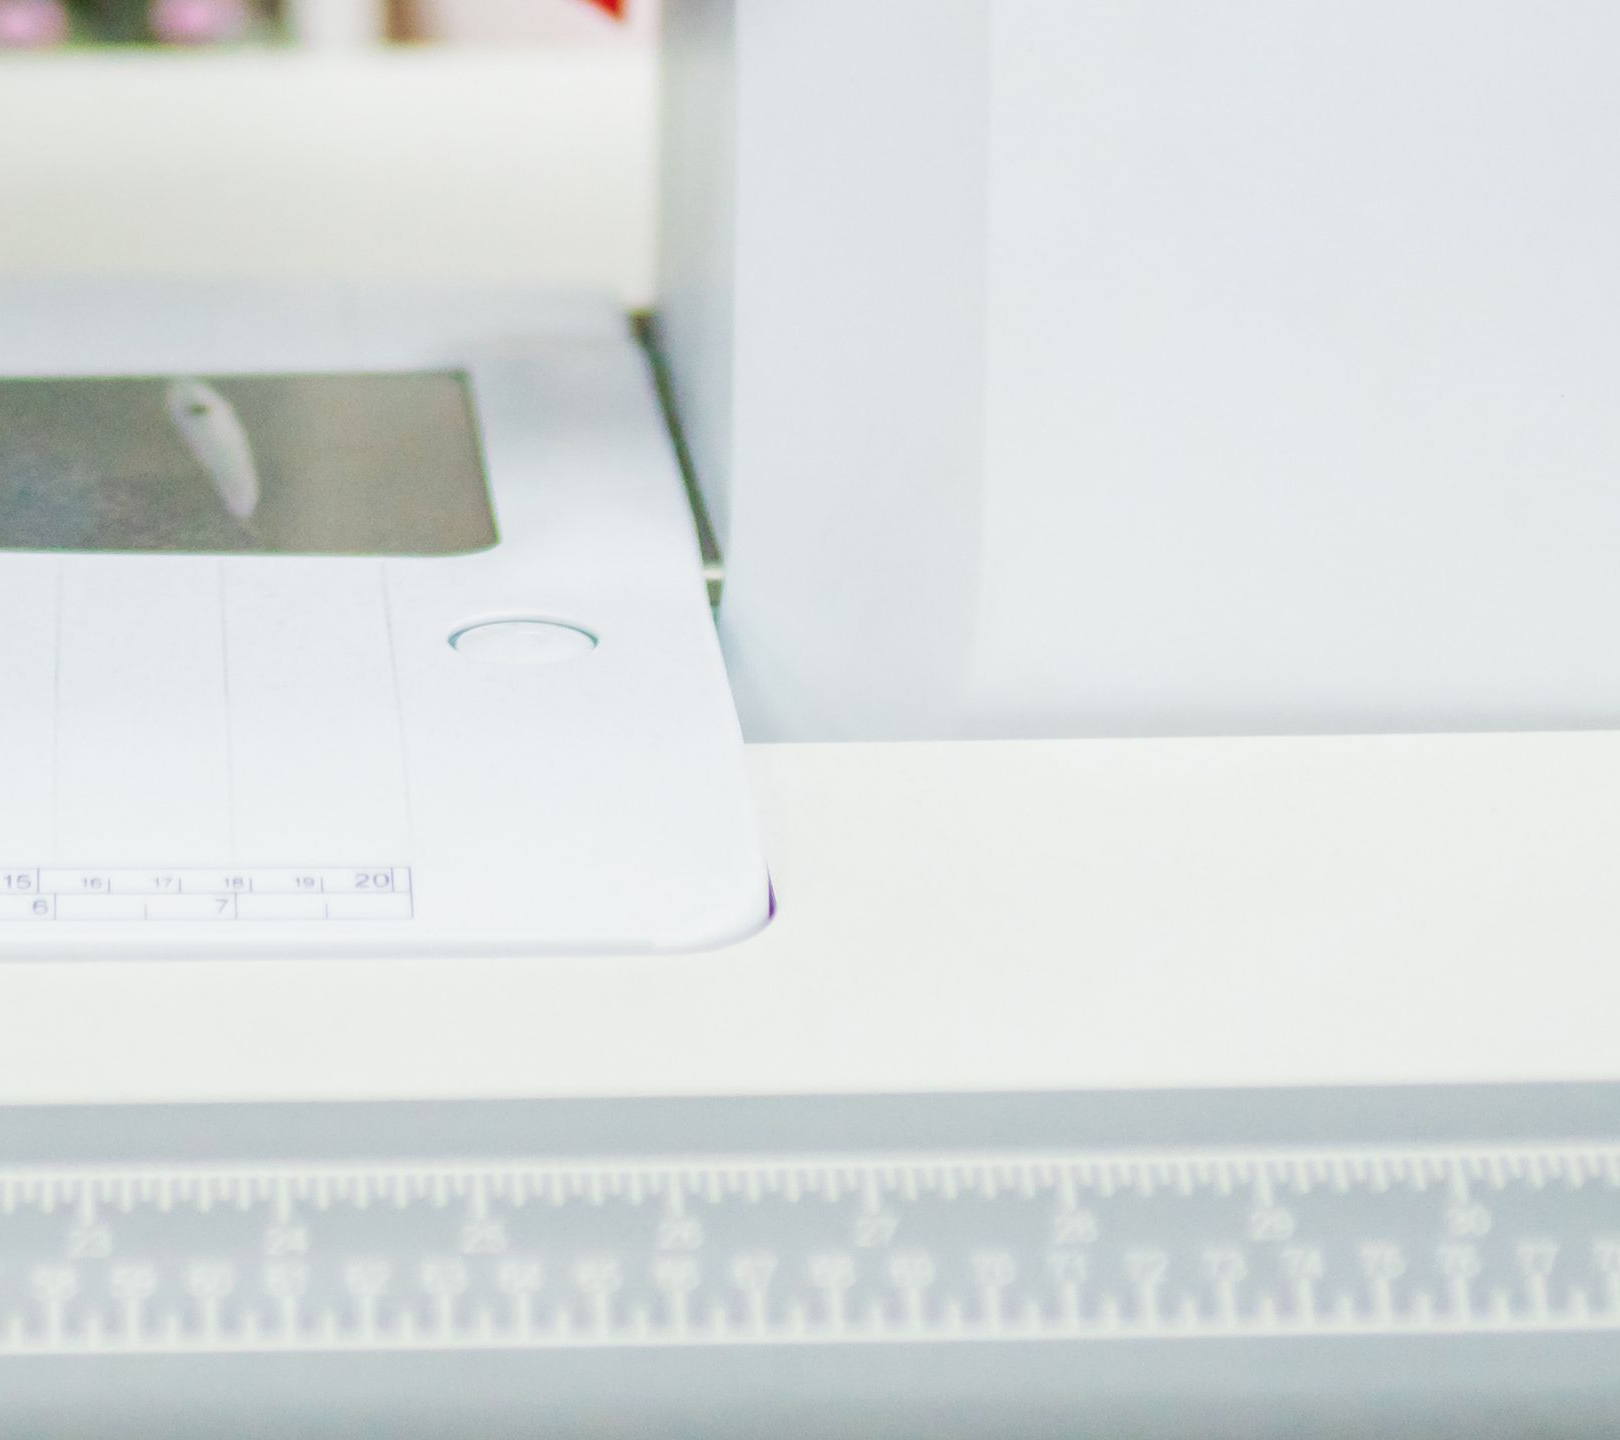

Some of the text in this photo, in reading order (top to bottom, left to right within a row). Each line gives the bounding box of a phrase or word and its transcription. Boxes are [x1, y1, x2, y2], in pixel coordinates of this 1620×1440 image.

[4, 874, 32, 890] 15
[82, 878, 103, 890] 16
[153, 878, 173, 889] 17
[224, 877, 244, 889] 18
[294, 877, 315, 889] 19
[354, 873, 390, 888] 20
[32, 899, 48, 916] 6
